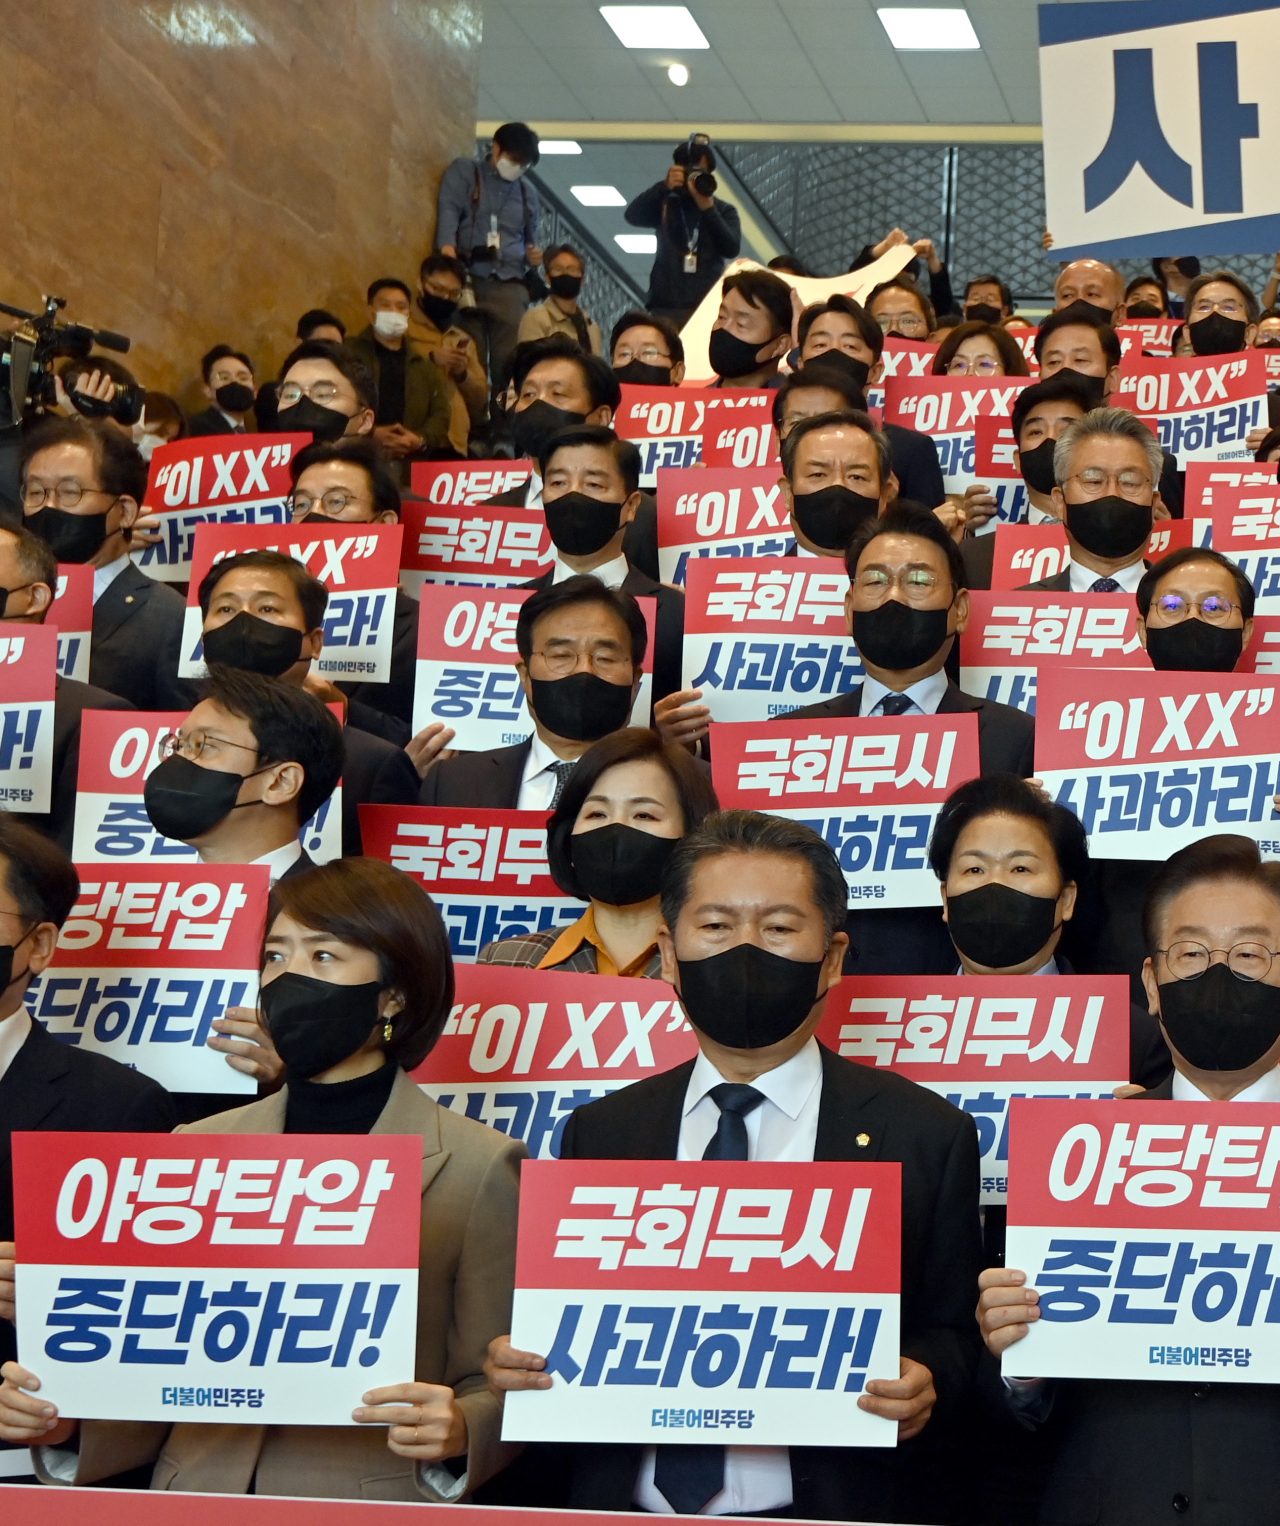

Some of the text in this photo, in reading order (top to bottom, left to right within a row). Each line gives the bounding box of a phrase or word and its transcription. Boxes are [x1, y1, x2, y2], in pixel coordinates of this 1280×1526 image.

[1120, 374, 1169, 411] “이
[1175, 359, 1248, 408] XX”
[155, 443, 292, 507] “이 XX”
[418, 516, 557, 568] 국회무
[982, 605, 1147, 658] 국회무
[318, 660, 376, 674] 더불어민주당
[1058, 688, 1275, 760] “이 XX”
[737, 731, 957, 797] 국회무시
[838, 995, 1105, 1067] 국회무시
[55, 1158, 394, 1245] 야당탄압
[553, 1184, 872, 1272] 국회무시
[44, 1278, 401, 1368] 중단하라!
[545, 1304, 882, 1393] 사과하라!
[1149, 1345, 1252, 1368] 더불어민주당
[162, 1387, 265, 1409] 더불어민주당
[651, 1408, 755, 1430] 더불어민주당
